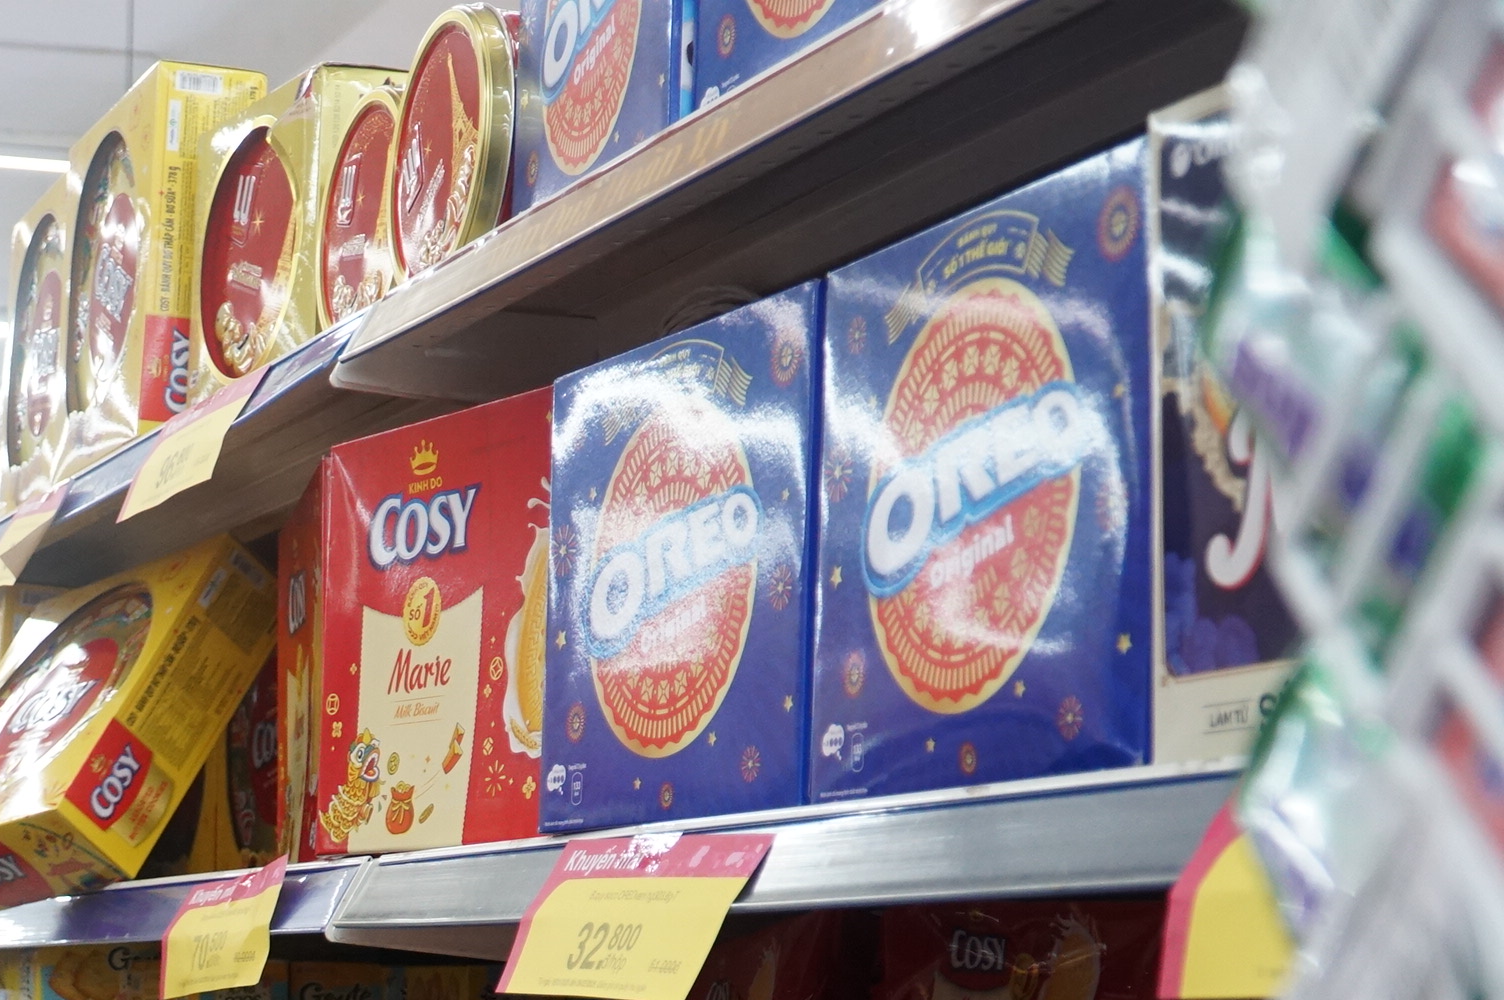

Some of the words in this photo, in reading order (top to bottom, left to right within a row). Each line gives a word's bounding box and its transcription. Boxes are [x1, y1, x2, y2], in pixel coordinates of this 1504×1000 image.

[163, 328, 190, 415] COSY
[408, 479, 429, 495] KINH
[868, 389, 1080, 577] OREO
[369, 487, 477, 567] COSY
[930, 514, 1015, 589] original
[590, 493, 759, 639] OREO
[422, 587, 435, 628] 1
[387, 648, 452, 695] Marie
[394, 704, 411, 719] Milk
[413, 703, 440, 717] Biscuit
[89, 743, 141, 821] COSY
[564, 845, 618, 876] Khuyến
[950, 929, 1006, 971] COSY
